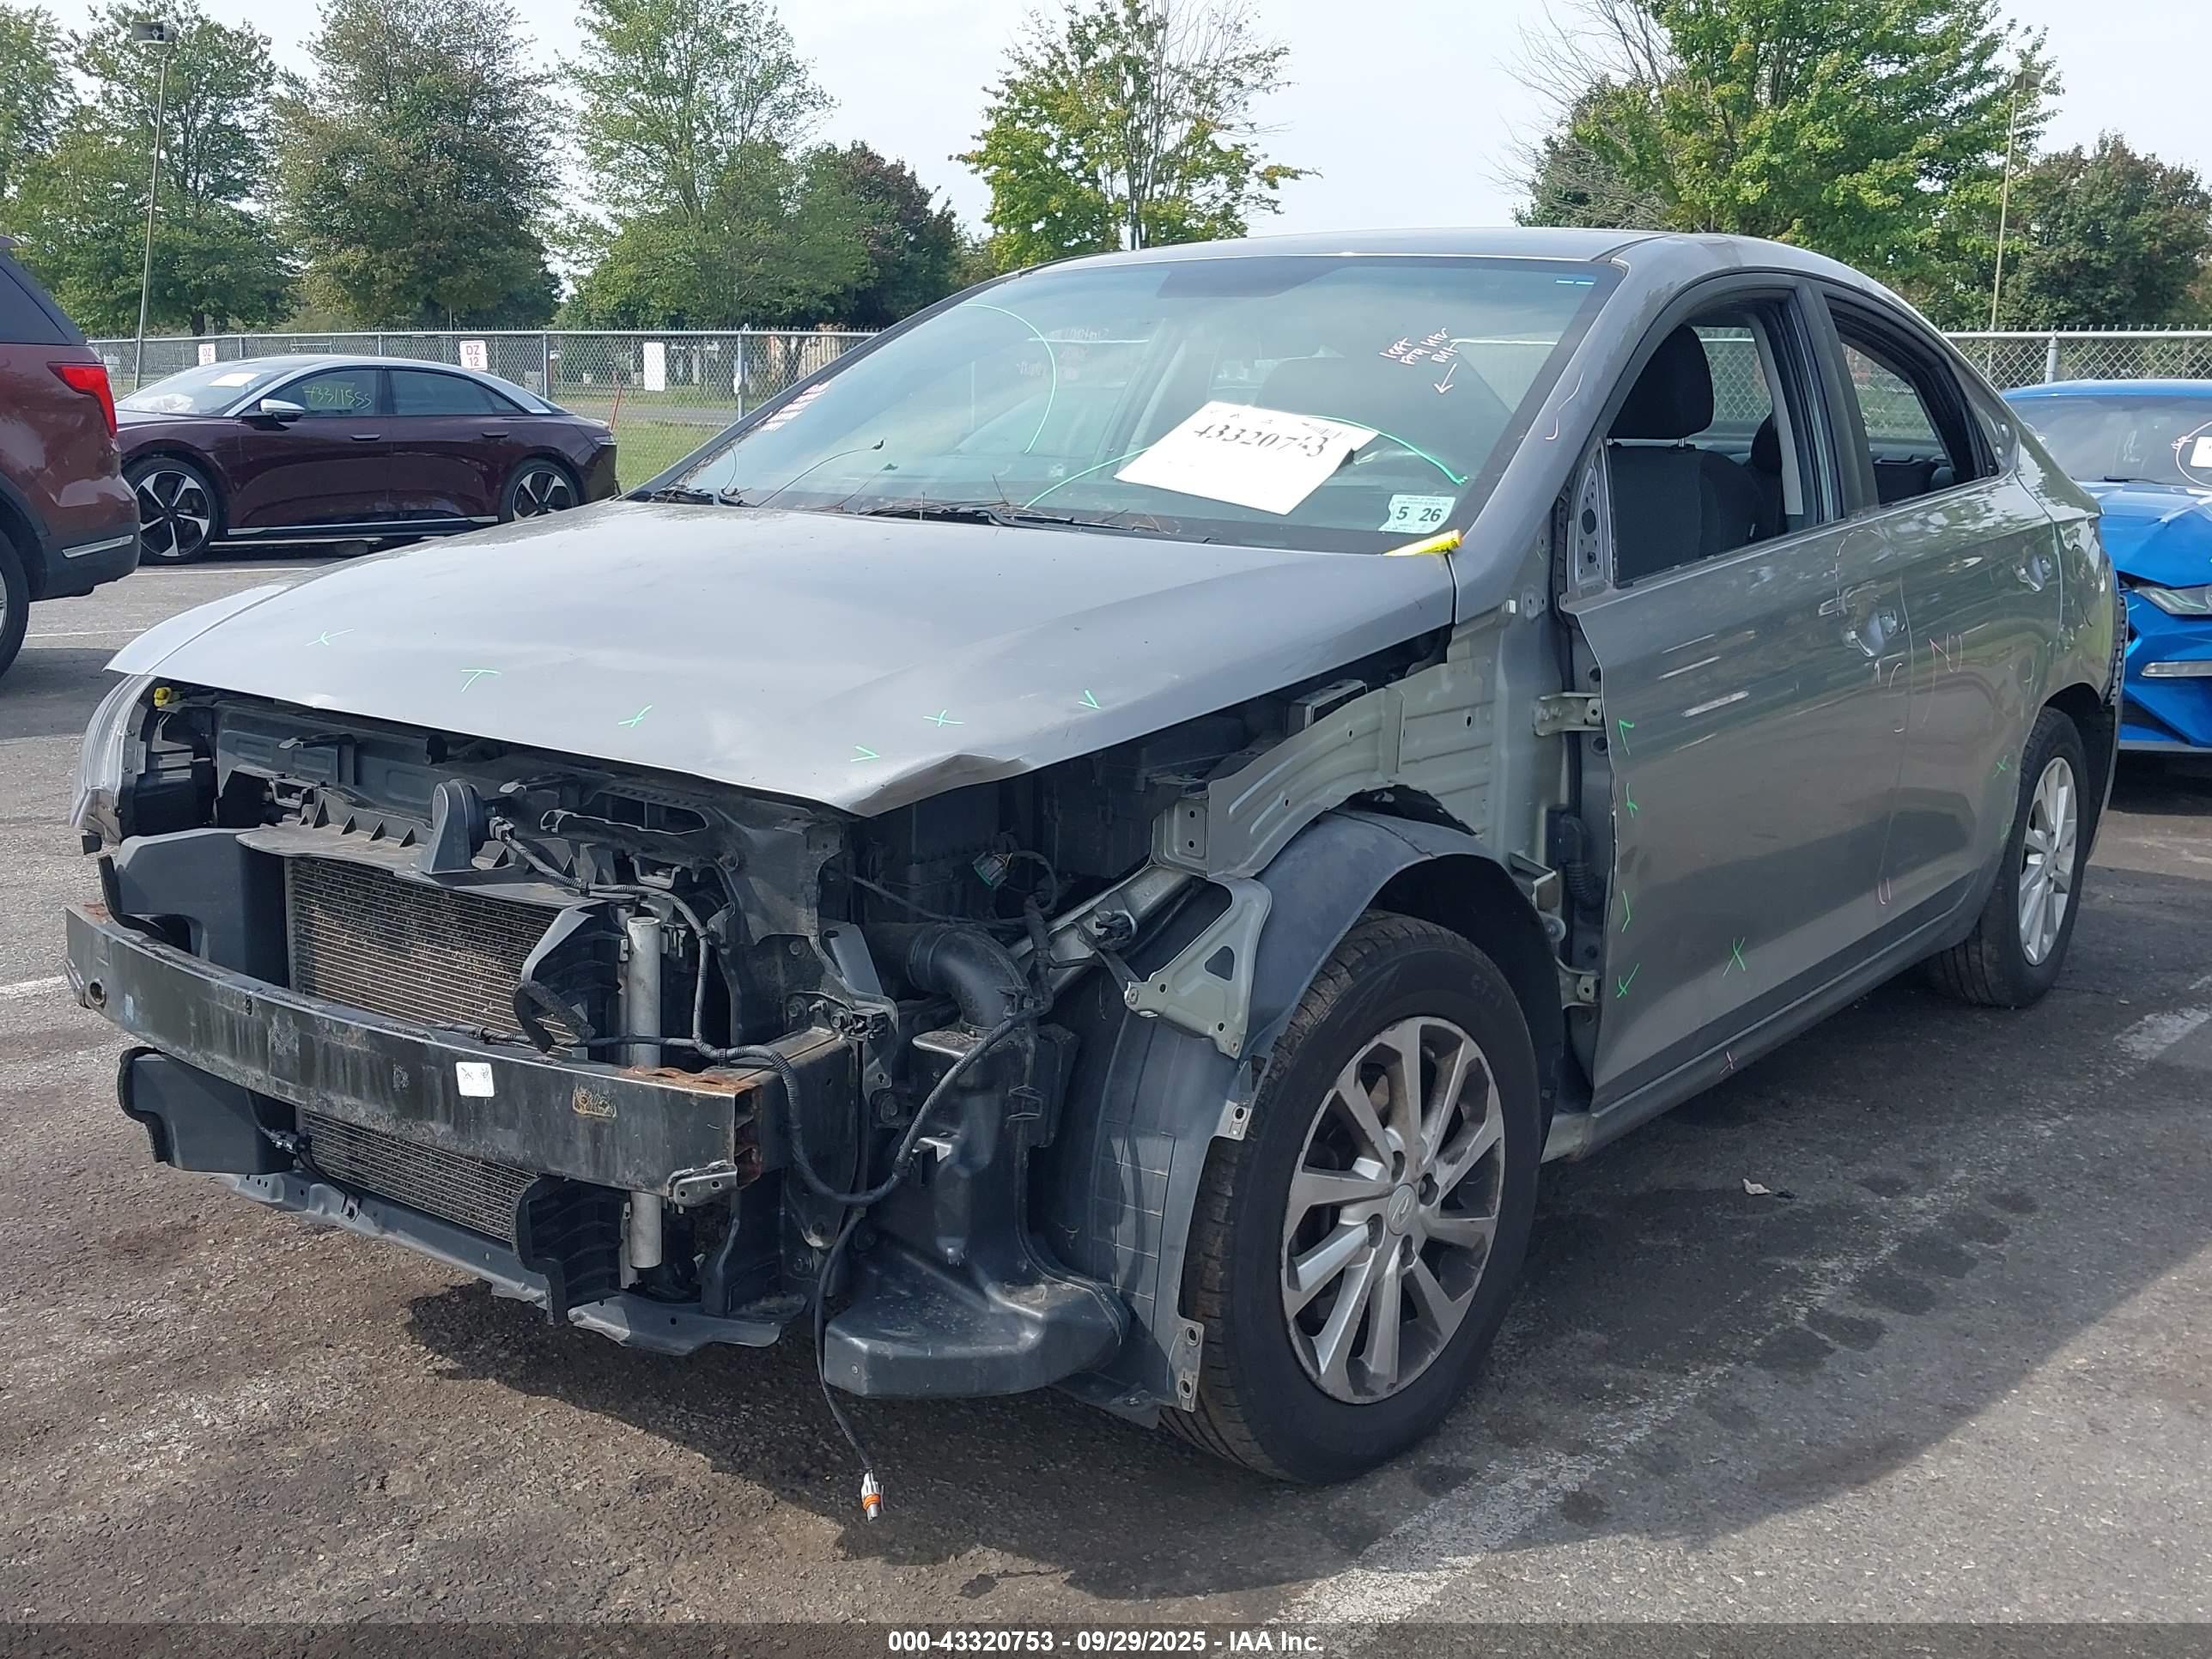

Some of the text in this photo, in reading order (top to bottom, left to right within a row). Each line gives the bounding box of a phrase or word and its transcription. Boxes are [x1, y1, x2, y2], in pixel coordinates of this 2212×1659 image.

[202, 347, 212, 357] DZ
[465, 344, 481, 356] DZ
[468, 356, 480, 368] 12
[1395, 506, 1443, 523] 5 26
